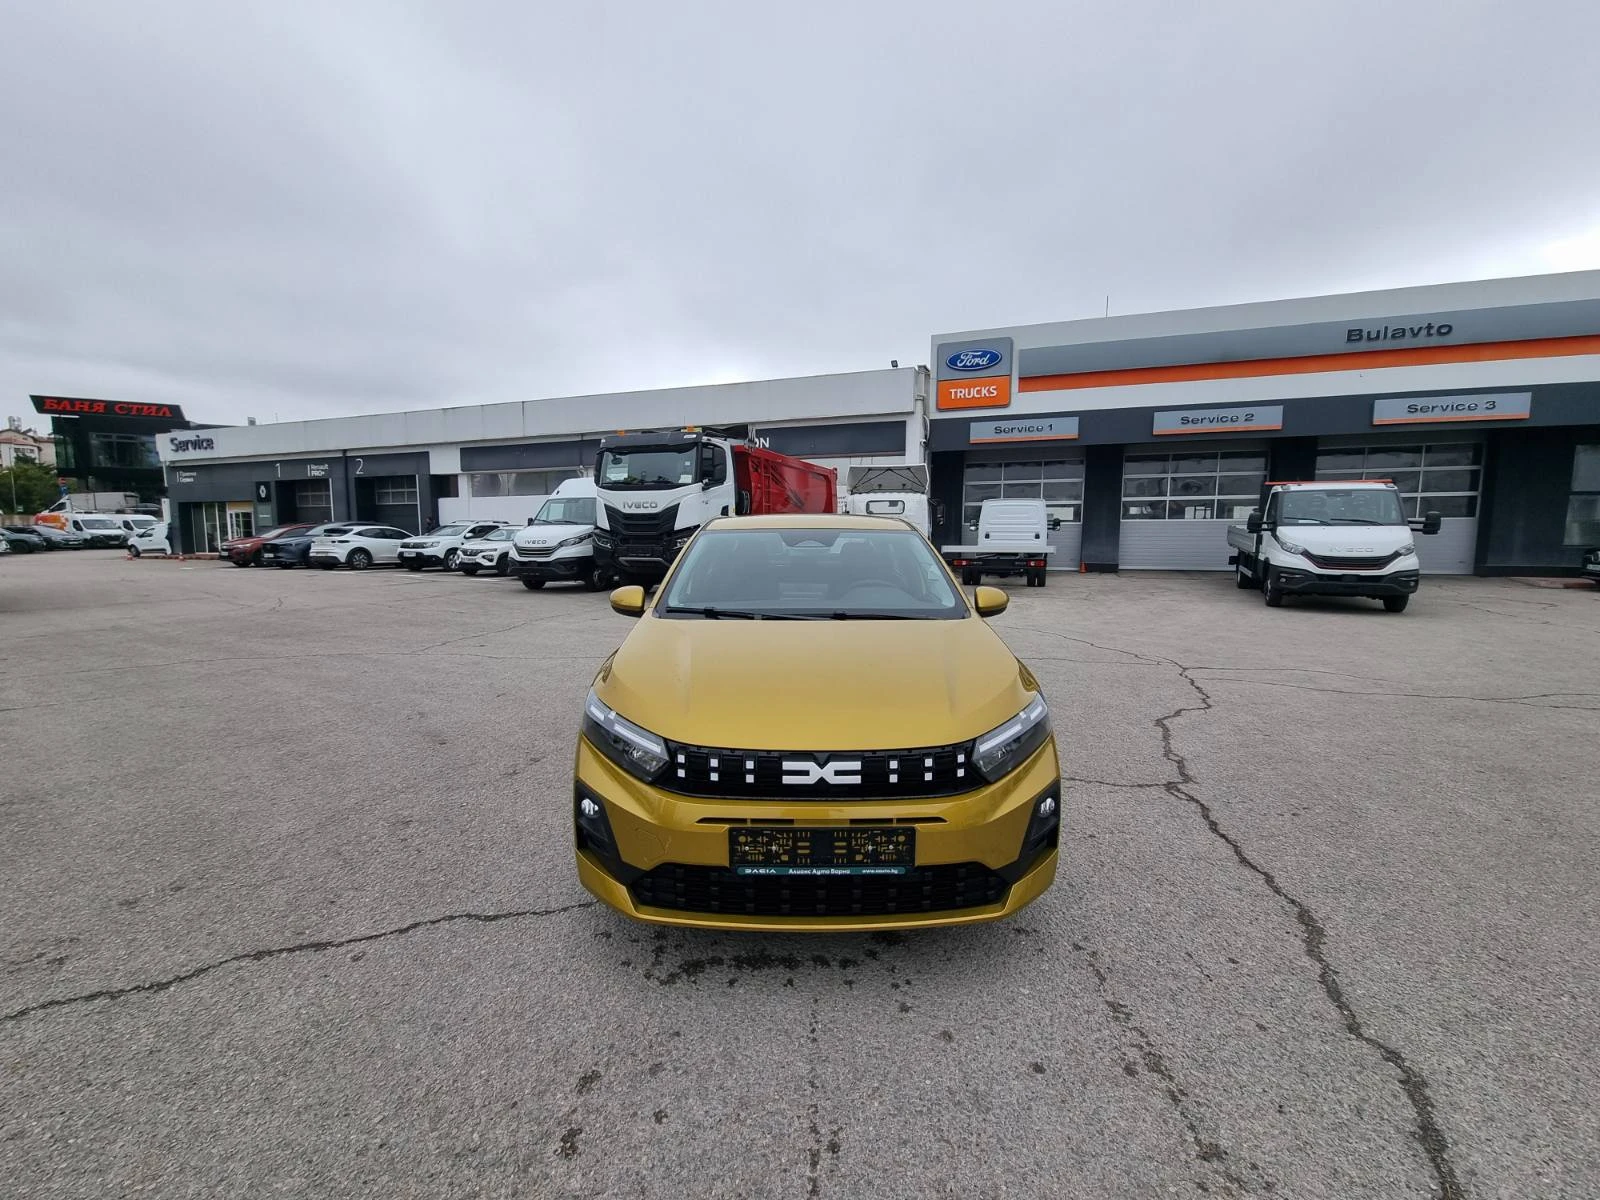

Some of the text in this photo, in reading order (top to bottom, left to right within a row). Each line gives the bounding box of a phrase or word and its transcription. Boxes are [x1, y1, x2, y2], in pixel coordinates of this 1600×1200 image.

[1346, 323, 1453, 344] Bulavto
[956, 352, 990, 367] Ford
[949, 385, 998, 400] TRUCKS
[43, 398, 173, 417] БАНЯ СТИЛ
[1406, 400, 1497, 414] Service 3
[1180, 412, 1255, 425] Service 2
[994, 423, 1053, 435] Service 1
[169, 434, 214, 453] Service
[275, 462, 281, 478] 1
[355, 458, 364, 474] 2
[622, 501, 658, 509] IVECO
